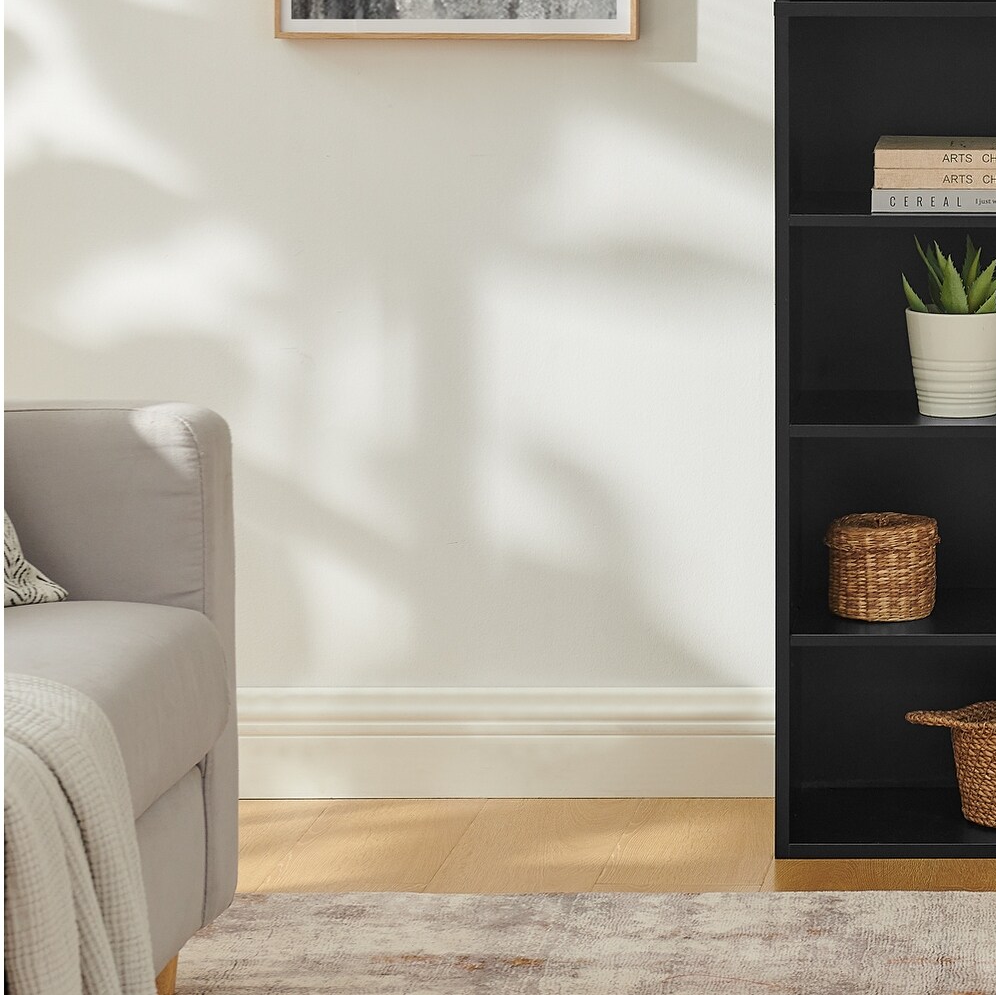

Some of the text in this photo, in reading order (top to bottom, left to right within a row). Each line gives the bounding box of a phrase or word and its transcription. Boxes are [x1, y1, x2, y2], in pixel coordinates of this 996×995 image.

[942, 154, 973, 164] ARTS
[942, 174, 974, 185] ARTS
[889, 196, 962, 208] CEREAL
[975, 198, 979, 206] I
[978, 198, 991, 207] just
